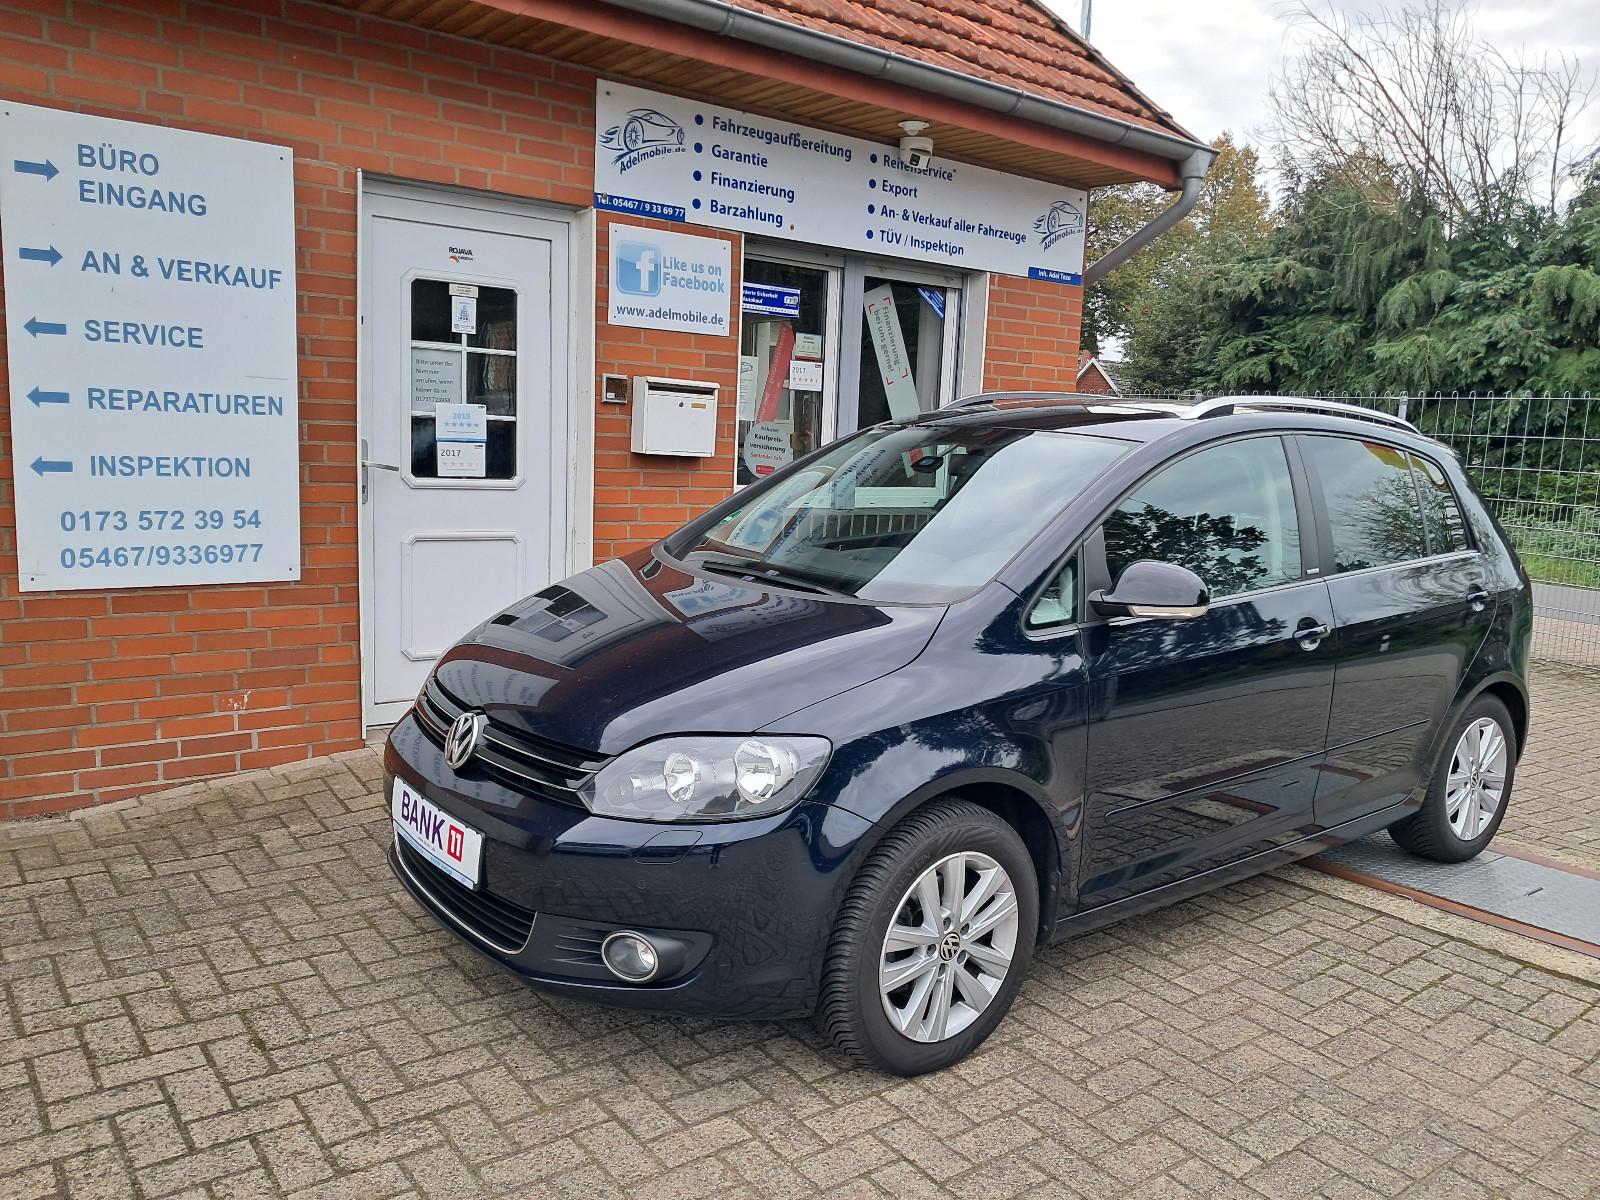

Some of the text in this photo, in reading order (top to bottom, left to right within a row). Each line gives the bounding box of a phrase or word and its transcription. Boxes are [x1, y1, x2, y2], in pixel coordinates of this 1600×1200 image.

[712, 116, 852, 162] Fahrzeugaufbereitung
[77, 142, 160, 176] BÜRO
[619, 146, 686, 175] Adelmobile.de
[711, 144, 768, 168] Garantie
[79, 179, 207, 217] EINGANG
[711, 171, 795, 203] Finanzierung
[882, 179, 918, 199] Export
[613, 198, 638, 210] 05467
[652, 204, 661, 213] 33
[663, 206, 673, 215] 69
[674, 208, 685, 217] 77
[710, 199, 783, 228] Barzahlung
[880, 204, 1027, 245] An- & Verkauf aller Fahrzeuge
[880, 228, 901, 245] TÜV
[910, 235, 964, 256] Inspektion
[81, 251, 282, 290] AN & VERKAUF
[663, 256, 721, 276] Like us on
[663, 272, 724, 293] Facebook
[617, 305, 723, 326] www.adelmobile.de
[84, 319, 204, 349] SERVICE
[792, 366, 806, 374] 2017
[87, 387, 283, 417] REPARATUREN
[90, 455, 250, 478] INSPEKTION
[441, 449, 461, 457] 2017
[60, 509, 262, 532] 0173 572 39 54
[60, 543, 263, 569] 05467/9336977
[401, 789, 446, 851] BANK
